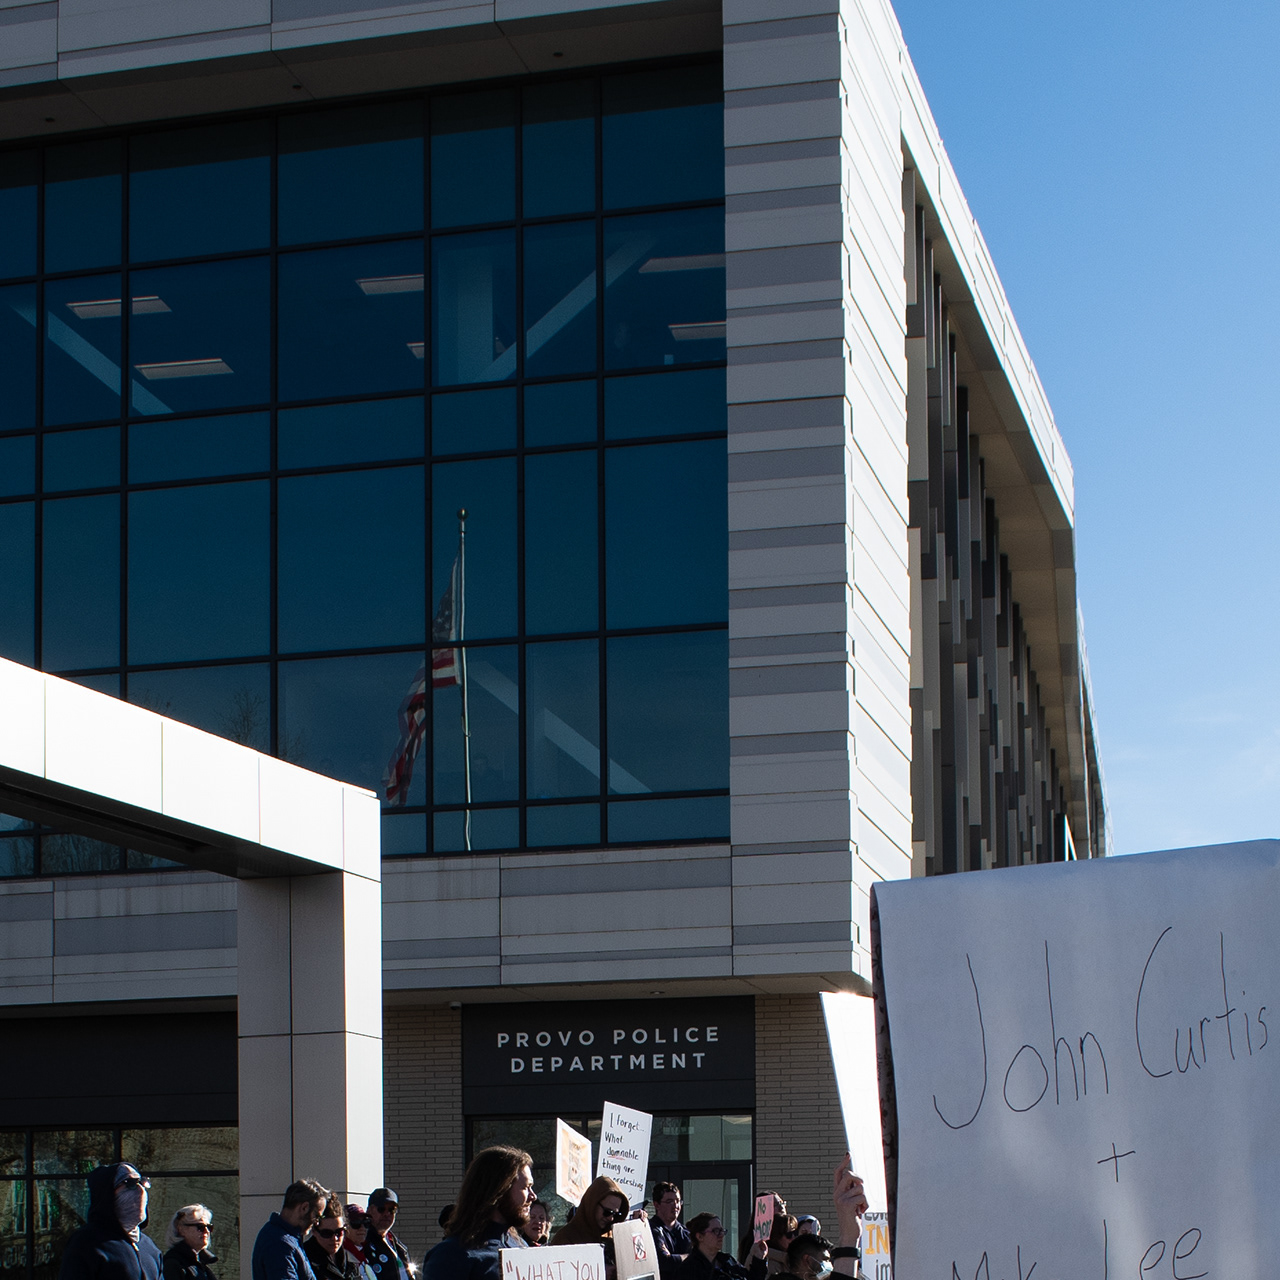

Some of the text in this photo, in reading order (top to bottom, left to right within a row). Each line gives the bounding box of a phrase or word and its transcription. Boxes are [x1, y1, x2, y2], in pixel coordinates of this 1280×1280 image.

[497, 1026, 719, 1048] PROVO POLICE
[932, 925, 1273, 1130] John Curtis
[511, 1053, 705, 1073] DEPARTMENT
[604, 1131, 624, 1144] What
[623, 1165, 635, 1175] are
